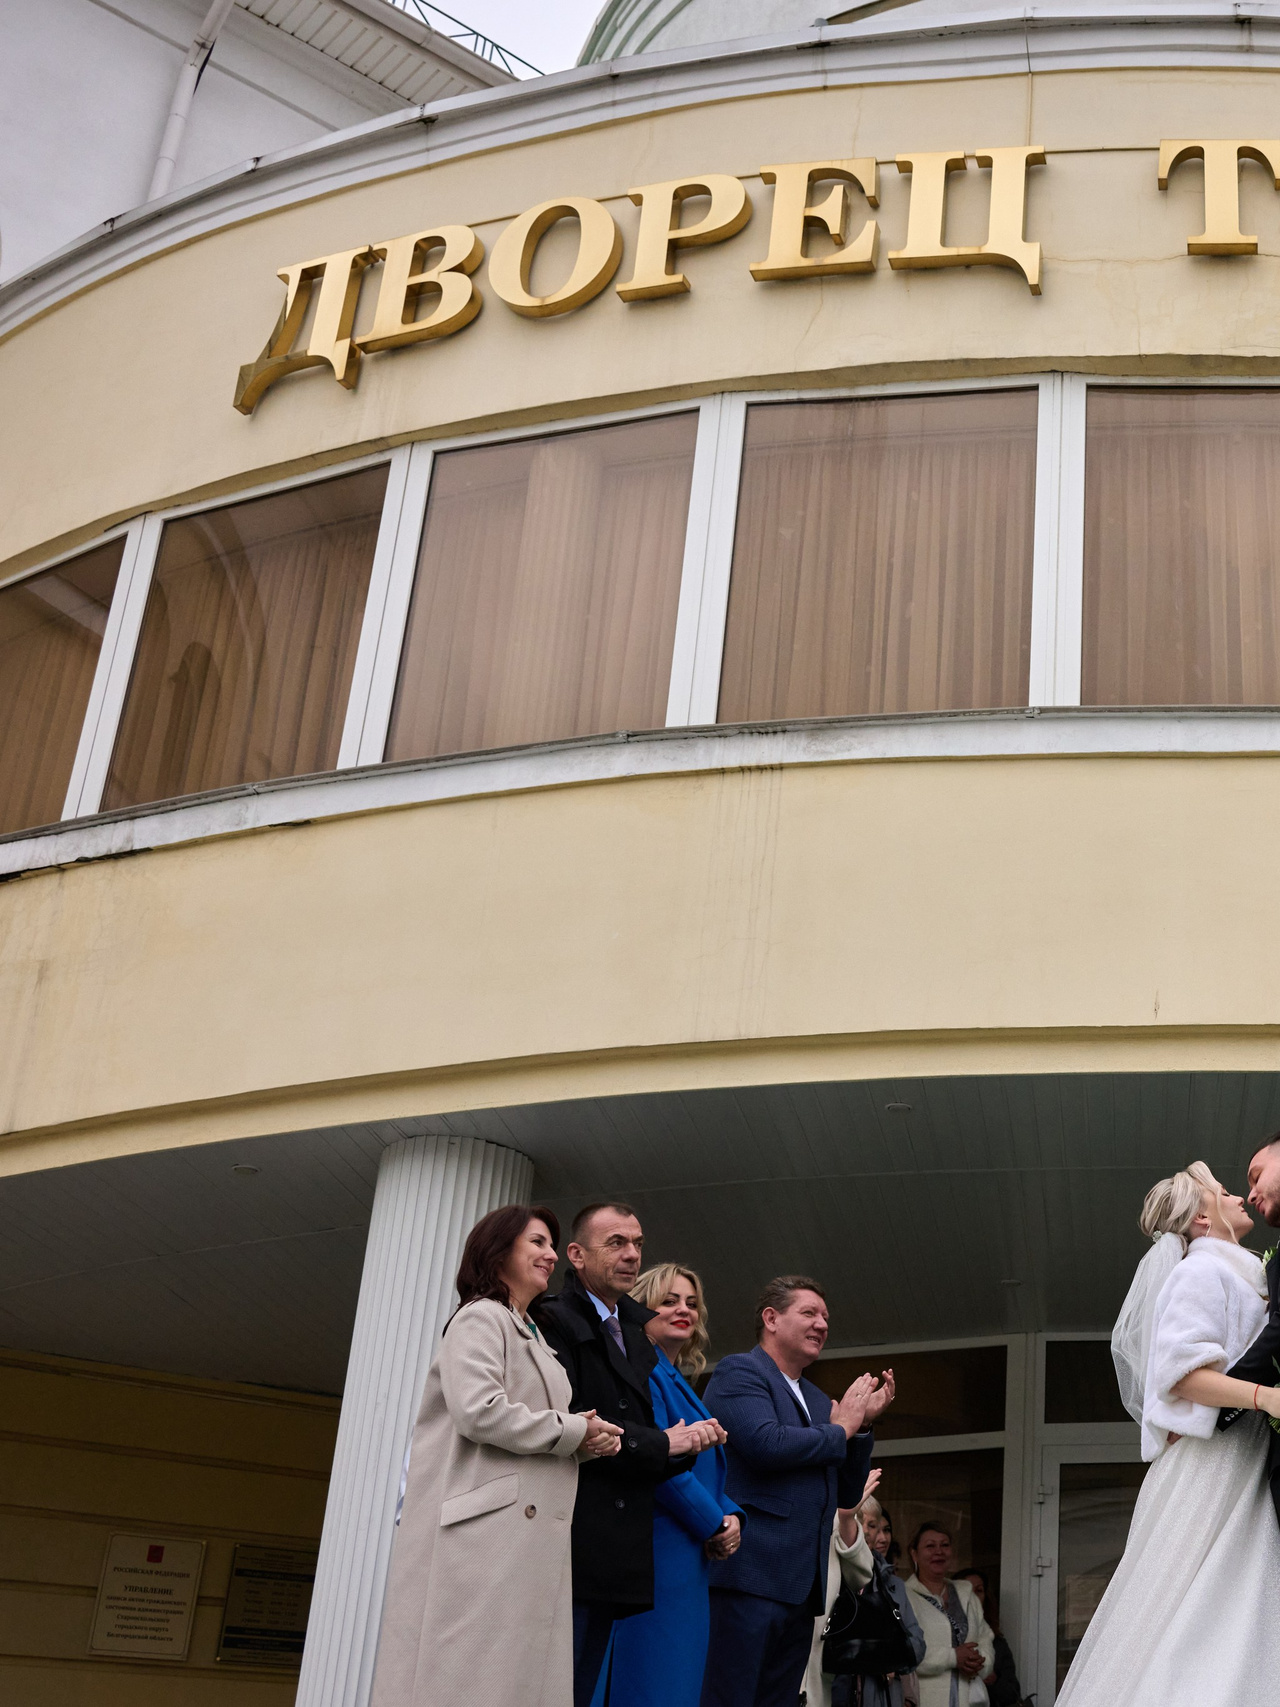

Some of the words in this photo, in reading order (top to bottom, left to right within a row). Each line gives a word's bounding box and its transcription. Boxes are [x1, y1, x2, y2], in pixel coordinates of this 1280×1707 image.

[233, 145, 1046, 416] ДВОРЕЦ
[113, 1566, 153, 1575] РОССИЙСКАЯ
[123, 1585, 174, 1595] УПРАВЛЕНИЕ
